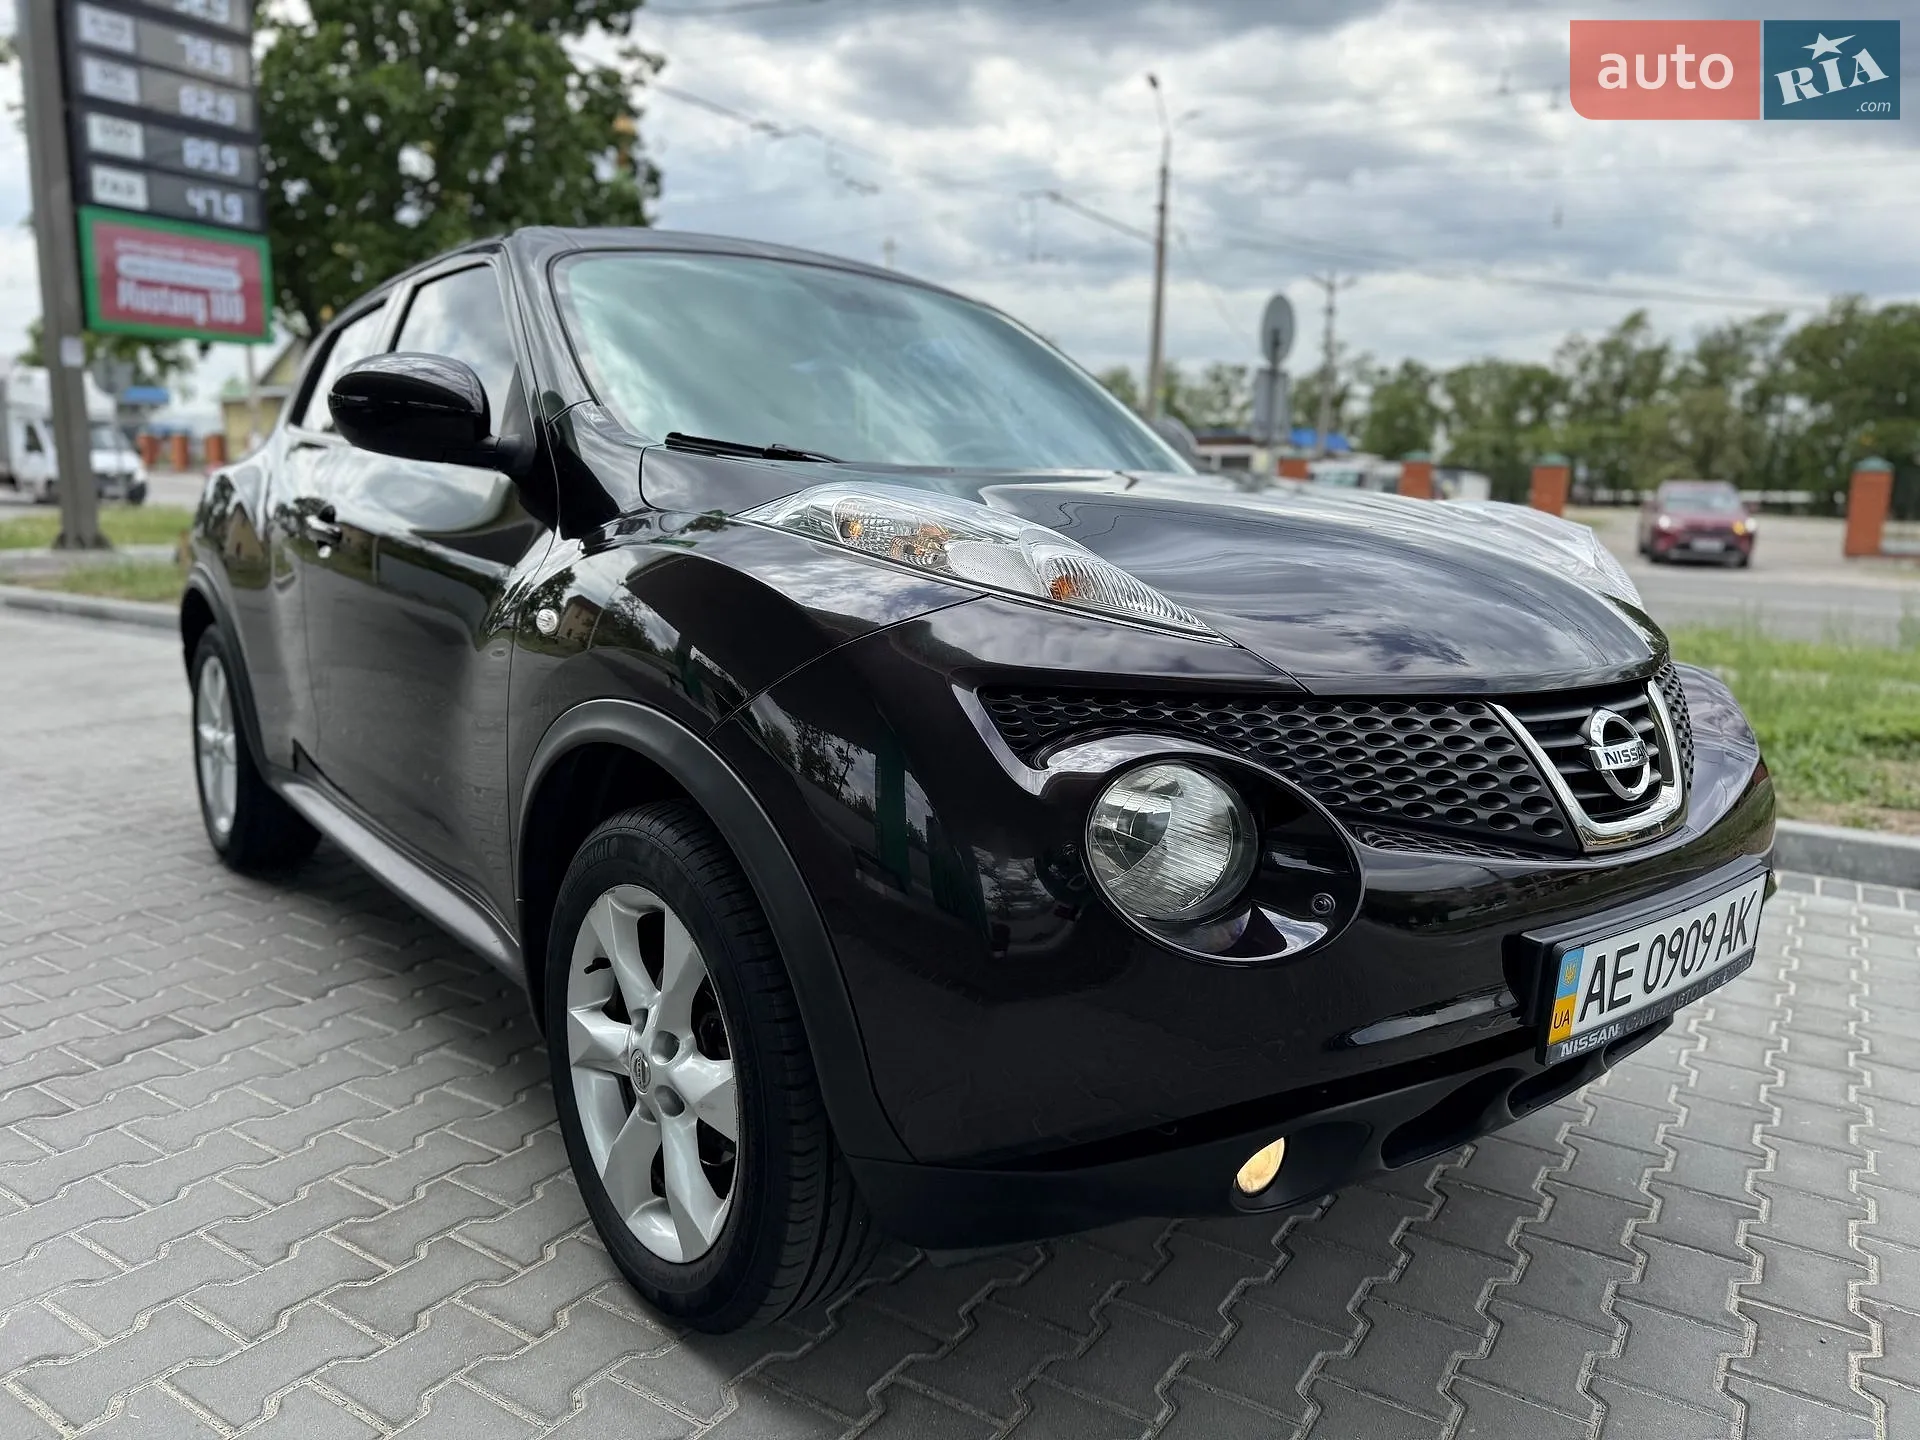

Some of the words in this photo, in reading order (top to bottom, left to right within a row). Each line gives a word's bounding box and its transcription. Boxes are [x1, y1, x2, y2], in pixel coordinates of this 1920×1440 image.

[1578, 942, 1640, 1023] AE
[1643, 911, 1717, 995] 0909
[1714, 890, 1758, 962] AK
[1553, 1011, 1570, 1030] UA
[1560, 1023, 1620, 1058] NISSAN
